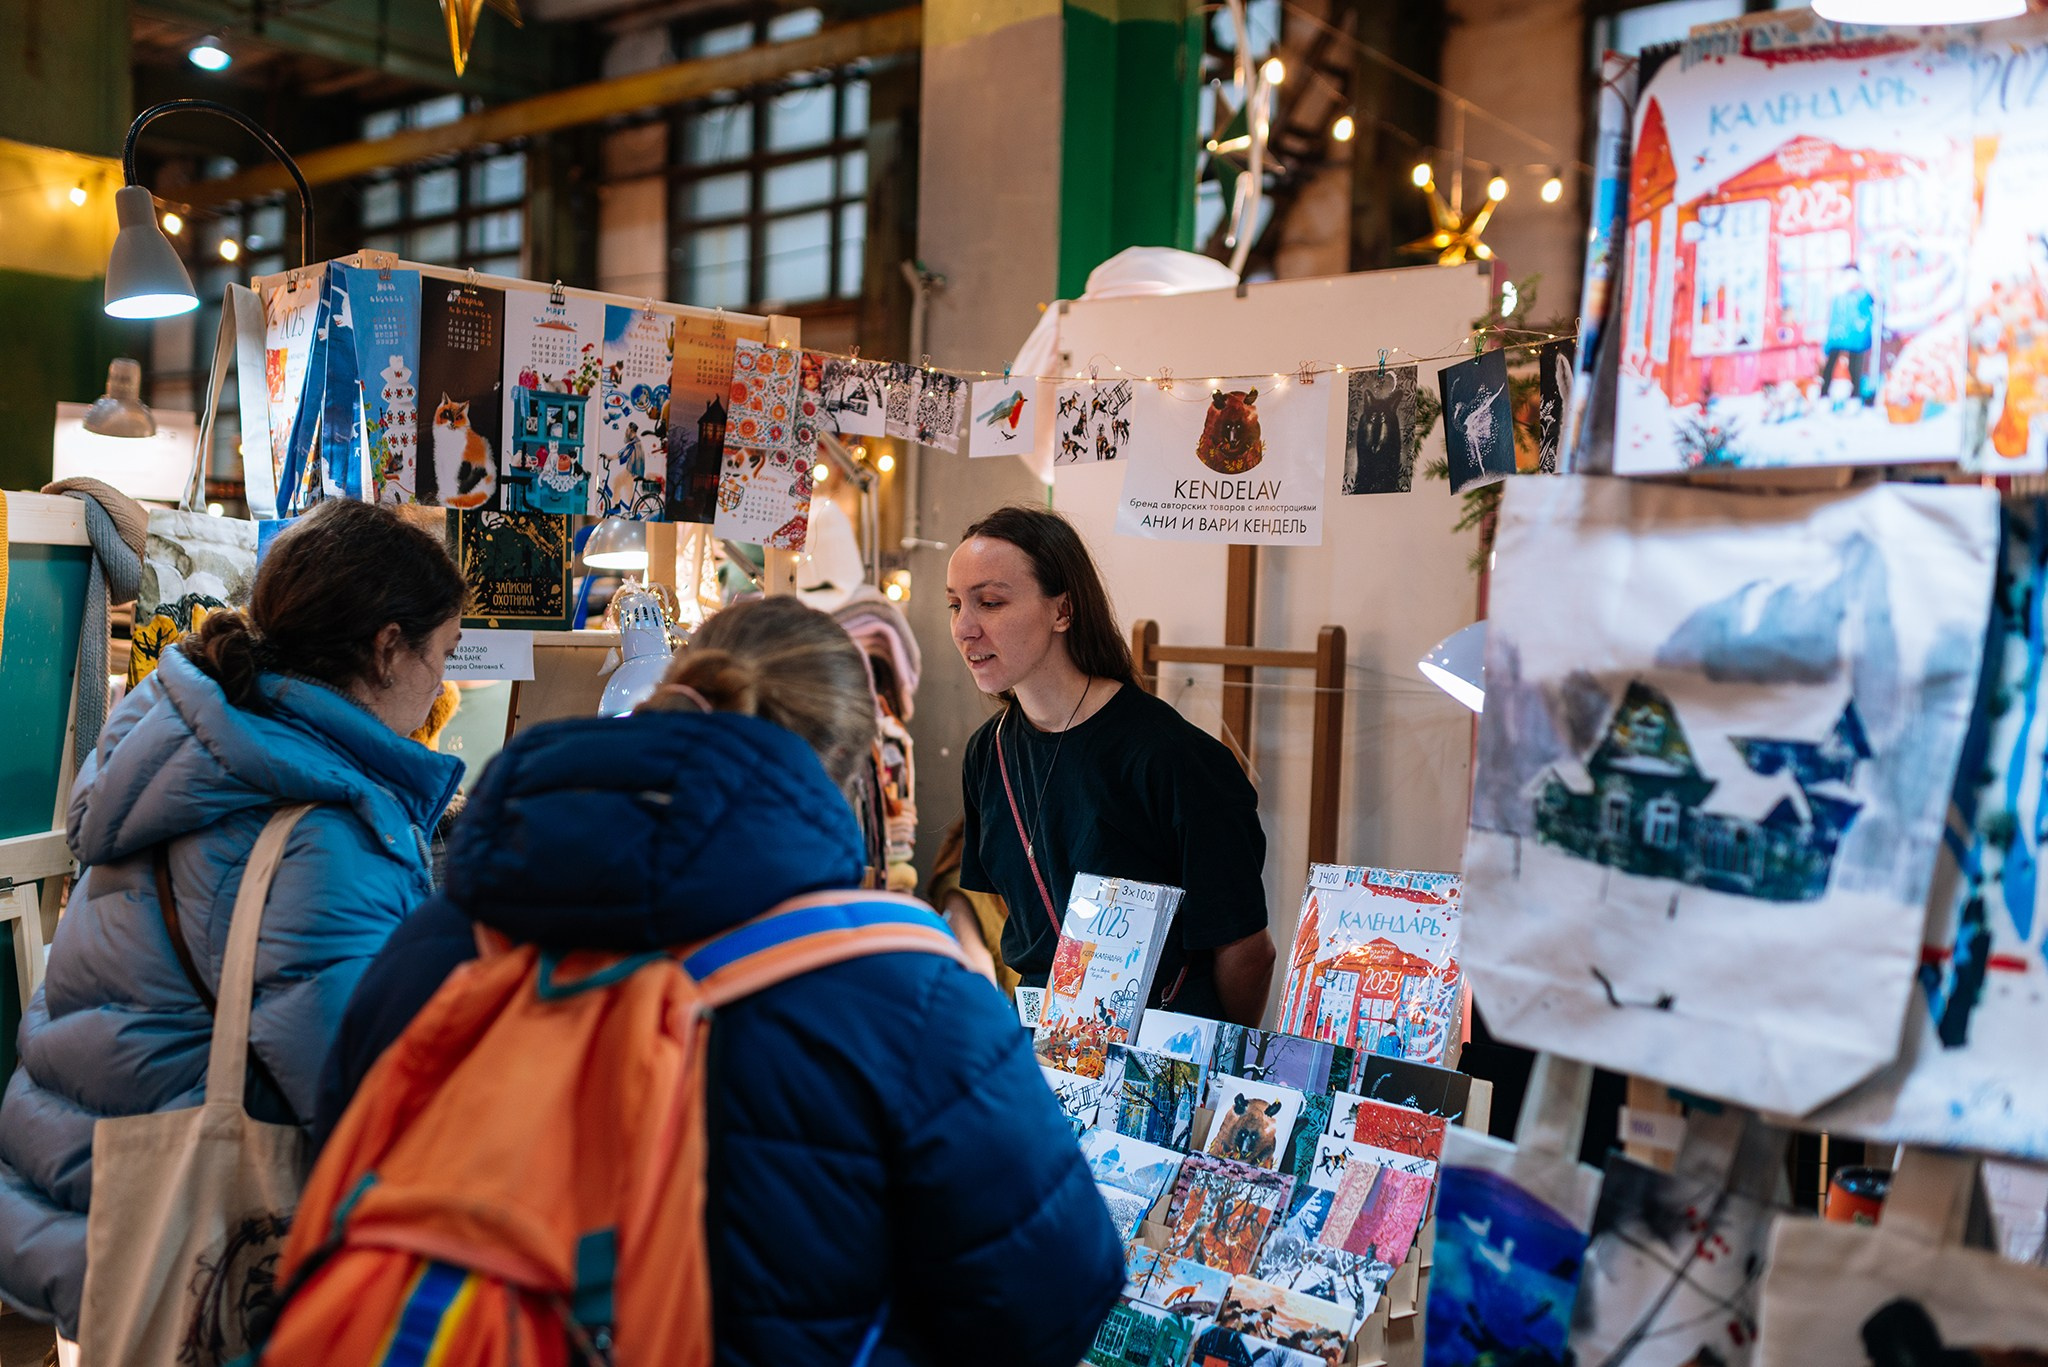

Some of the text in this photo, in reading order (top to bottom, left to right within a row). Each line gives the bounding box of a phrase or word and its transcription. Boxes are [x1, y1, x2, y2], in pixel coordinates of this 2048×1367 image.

[1777, 180, 1852, 231] 2025
[280, 305, 306, 340] 2025
[1174, 480, 1282, 501] KENDELAV
[1129, 497, 1159, 509] бренд
[1160, 502, 1208, 513] авторских
[1209, 504, 1246, 513] товаров
[1254, 504, 1317, 514] иллюстрациями
[1140, 515, 1308, 536] АНИ И ВАРИ КЕНДЕЛЬ
[495, 581, 532, 594] ЗАПИСКИ
[492, 594, 535, 606] ОХОТНИКА
[1319, 872, 1340, 885] 1400
[1086, 904, 1135, 939] 2025
[1339, 910, 1440, 936] КАЛЕНДАРЬ
[1362, 968, 1400, 994] 2025
